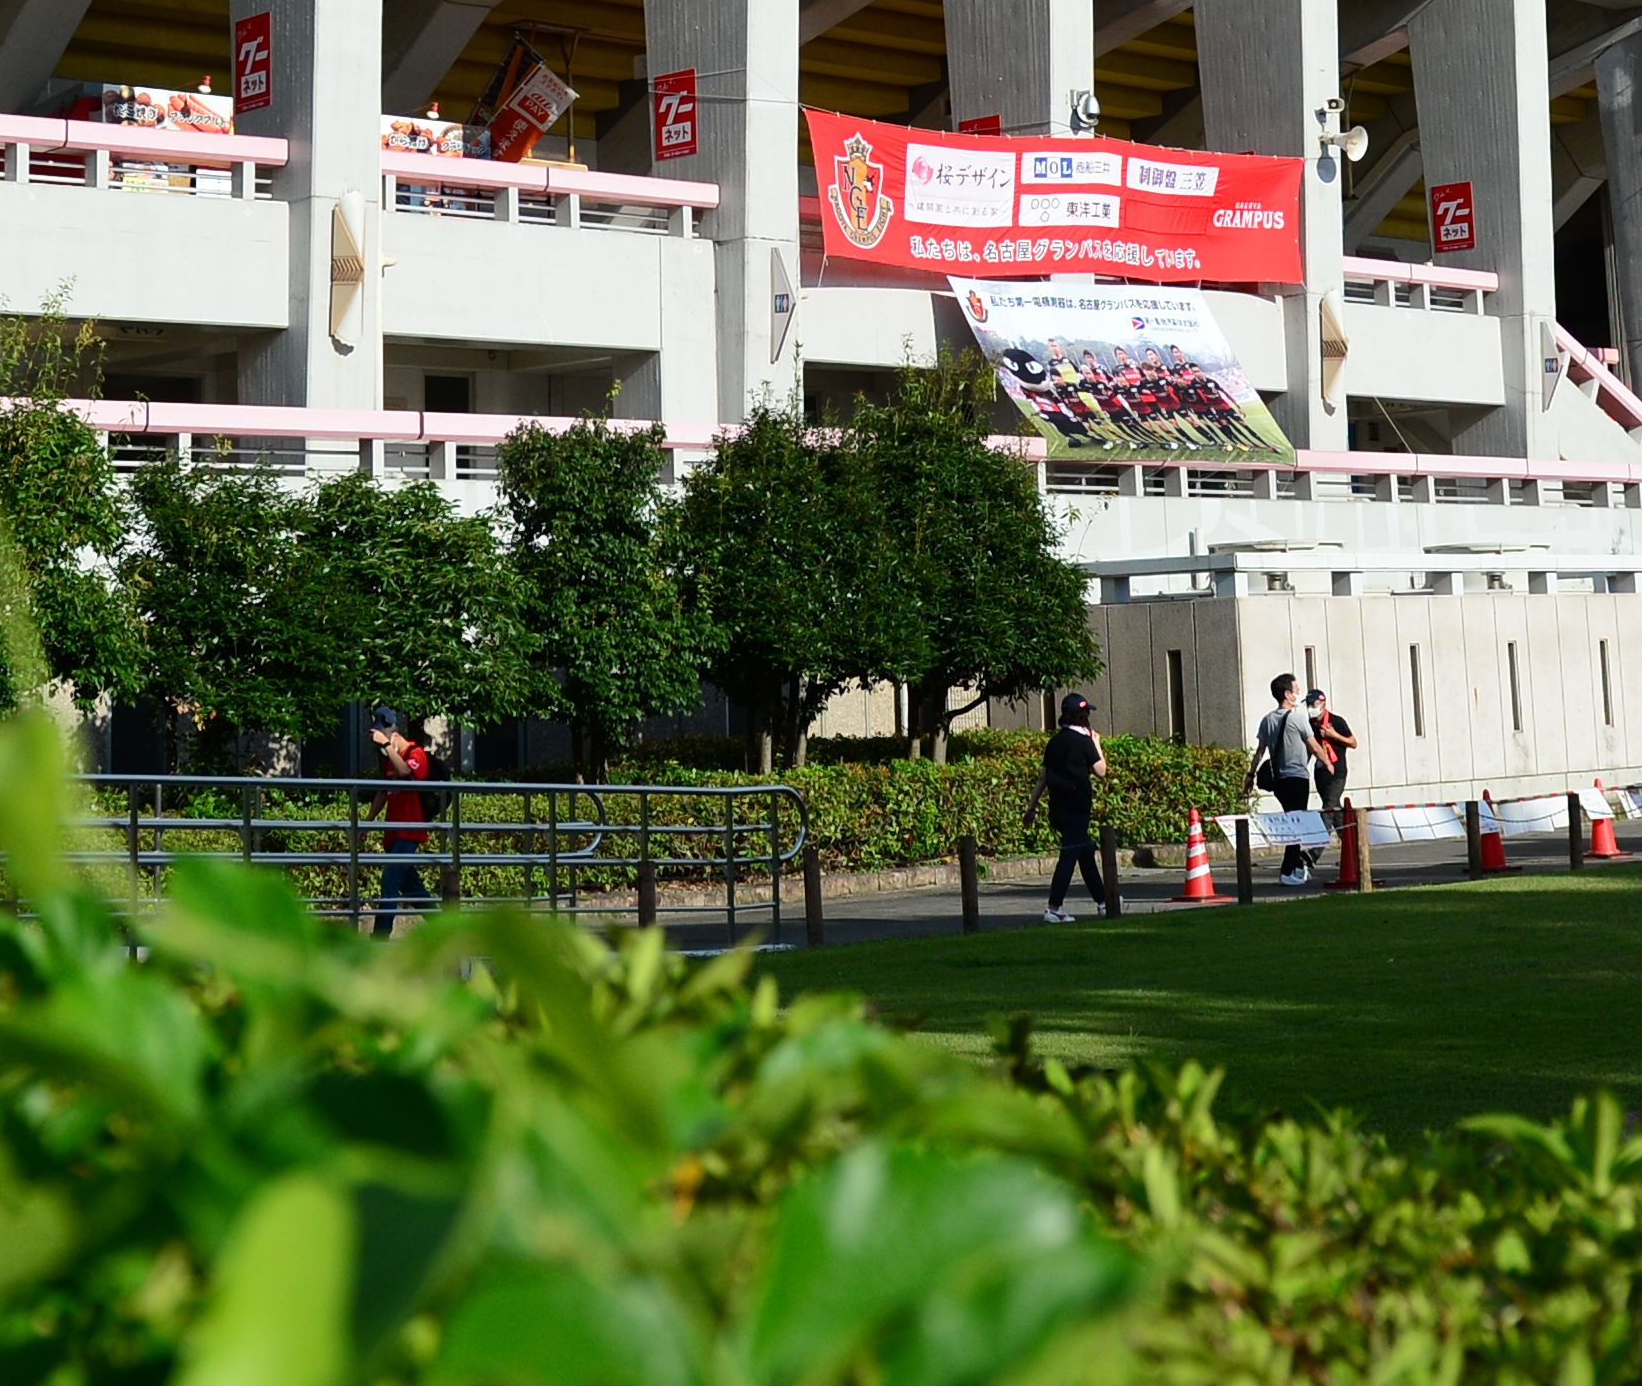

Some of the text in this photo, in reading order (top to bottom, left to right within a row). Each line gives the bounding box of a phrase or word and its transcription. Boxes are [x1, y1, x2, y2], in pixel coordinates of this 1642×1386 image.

[238, 36, 269, 75] グー
[242, 74, 264, 94] ネット
[524, 99, 547, 117] PAY
[658, 89, 694, 126] グー
[664, 125, 689, 143] ネット
[935, 163, 1012, 190] 桜デザイン
[1034, 160, 1073, 176] MOL
[1212, 209, 1286, 230] GRAMPUS
[1437, 198, 1471, 226] グー
[1443, 226, 1467, 239] ネット
[910, 234, 1202, 270] 私たちは、名古屋グランパスを応援しています。
